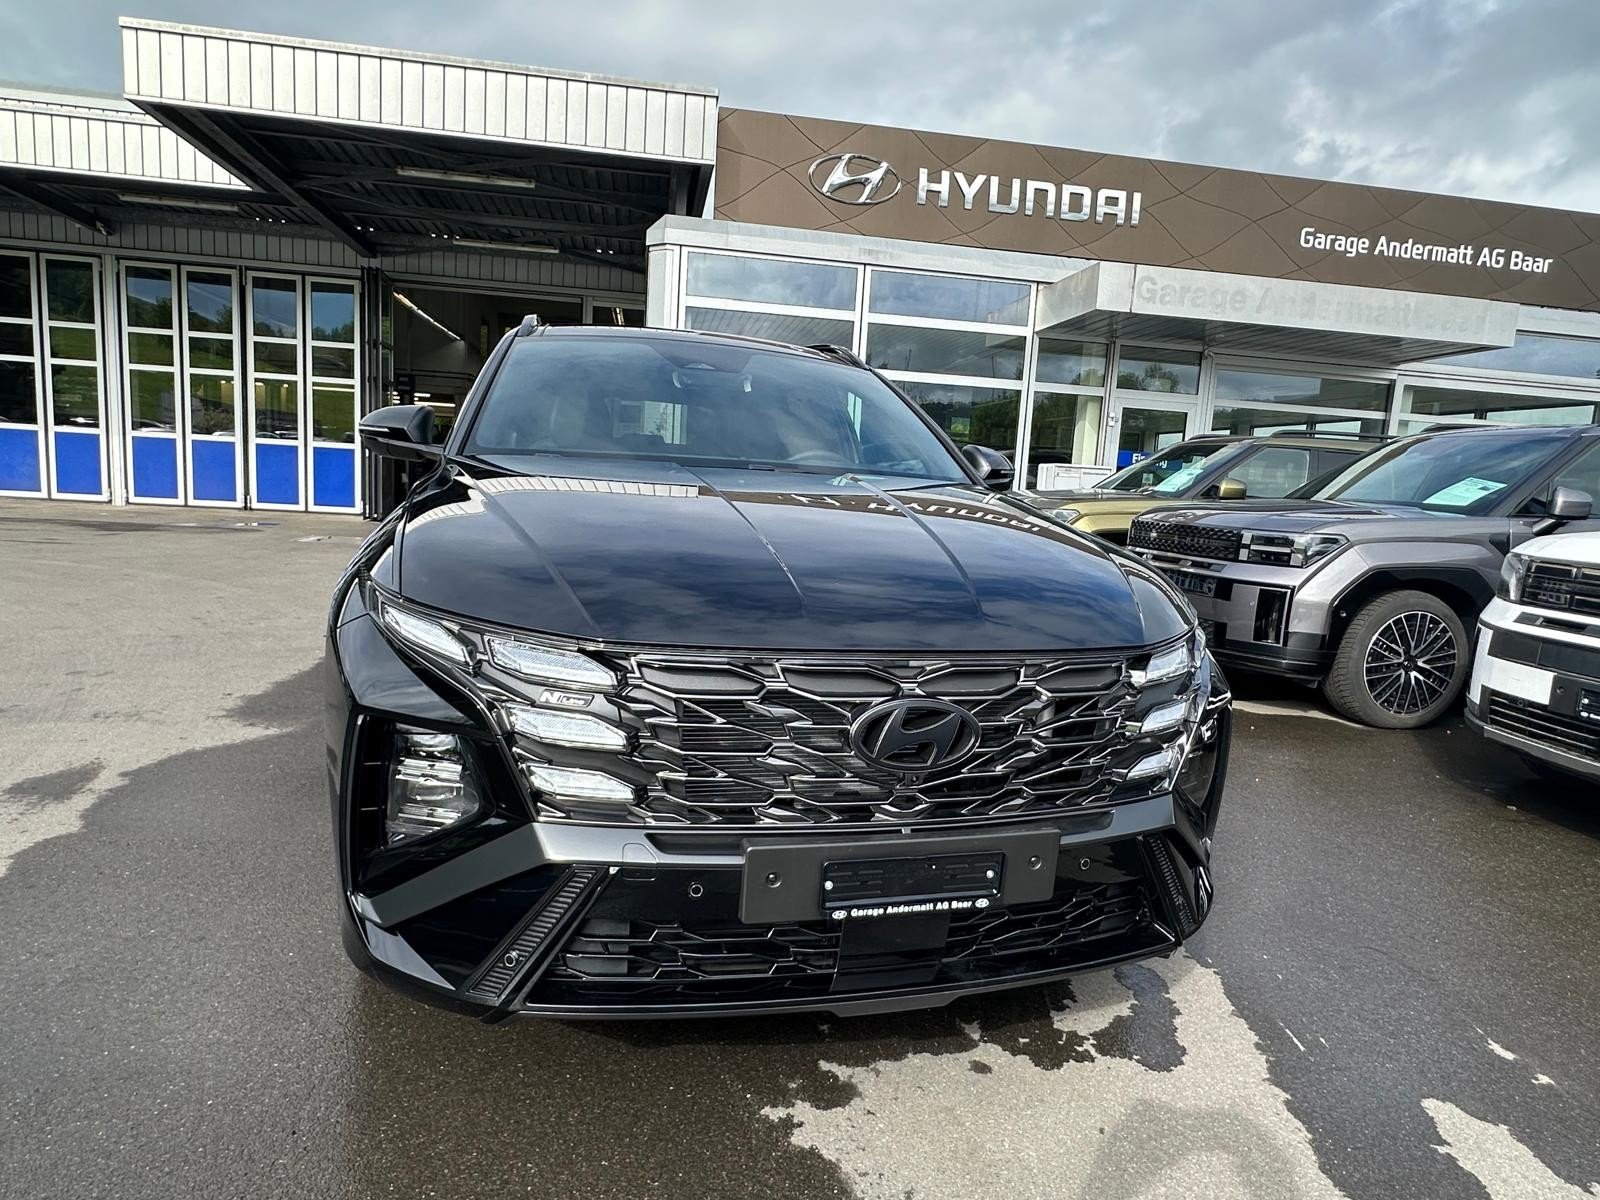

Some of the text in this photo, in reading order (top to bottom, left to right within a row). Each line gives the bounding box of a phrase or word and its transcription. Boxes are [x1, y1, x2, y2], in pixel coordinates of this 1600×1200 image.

[917, 167, 1142, 228] HYUNDAI
[1299, 227, 1554, 274] Garage Andermatt AG Baar
[1135, 275, 1247, 315] Garage
[540, 691, 560, 704] N
[851, 900, 973, 917] Garage Andermatt AG Baar
